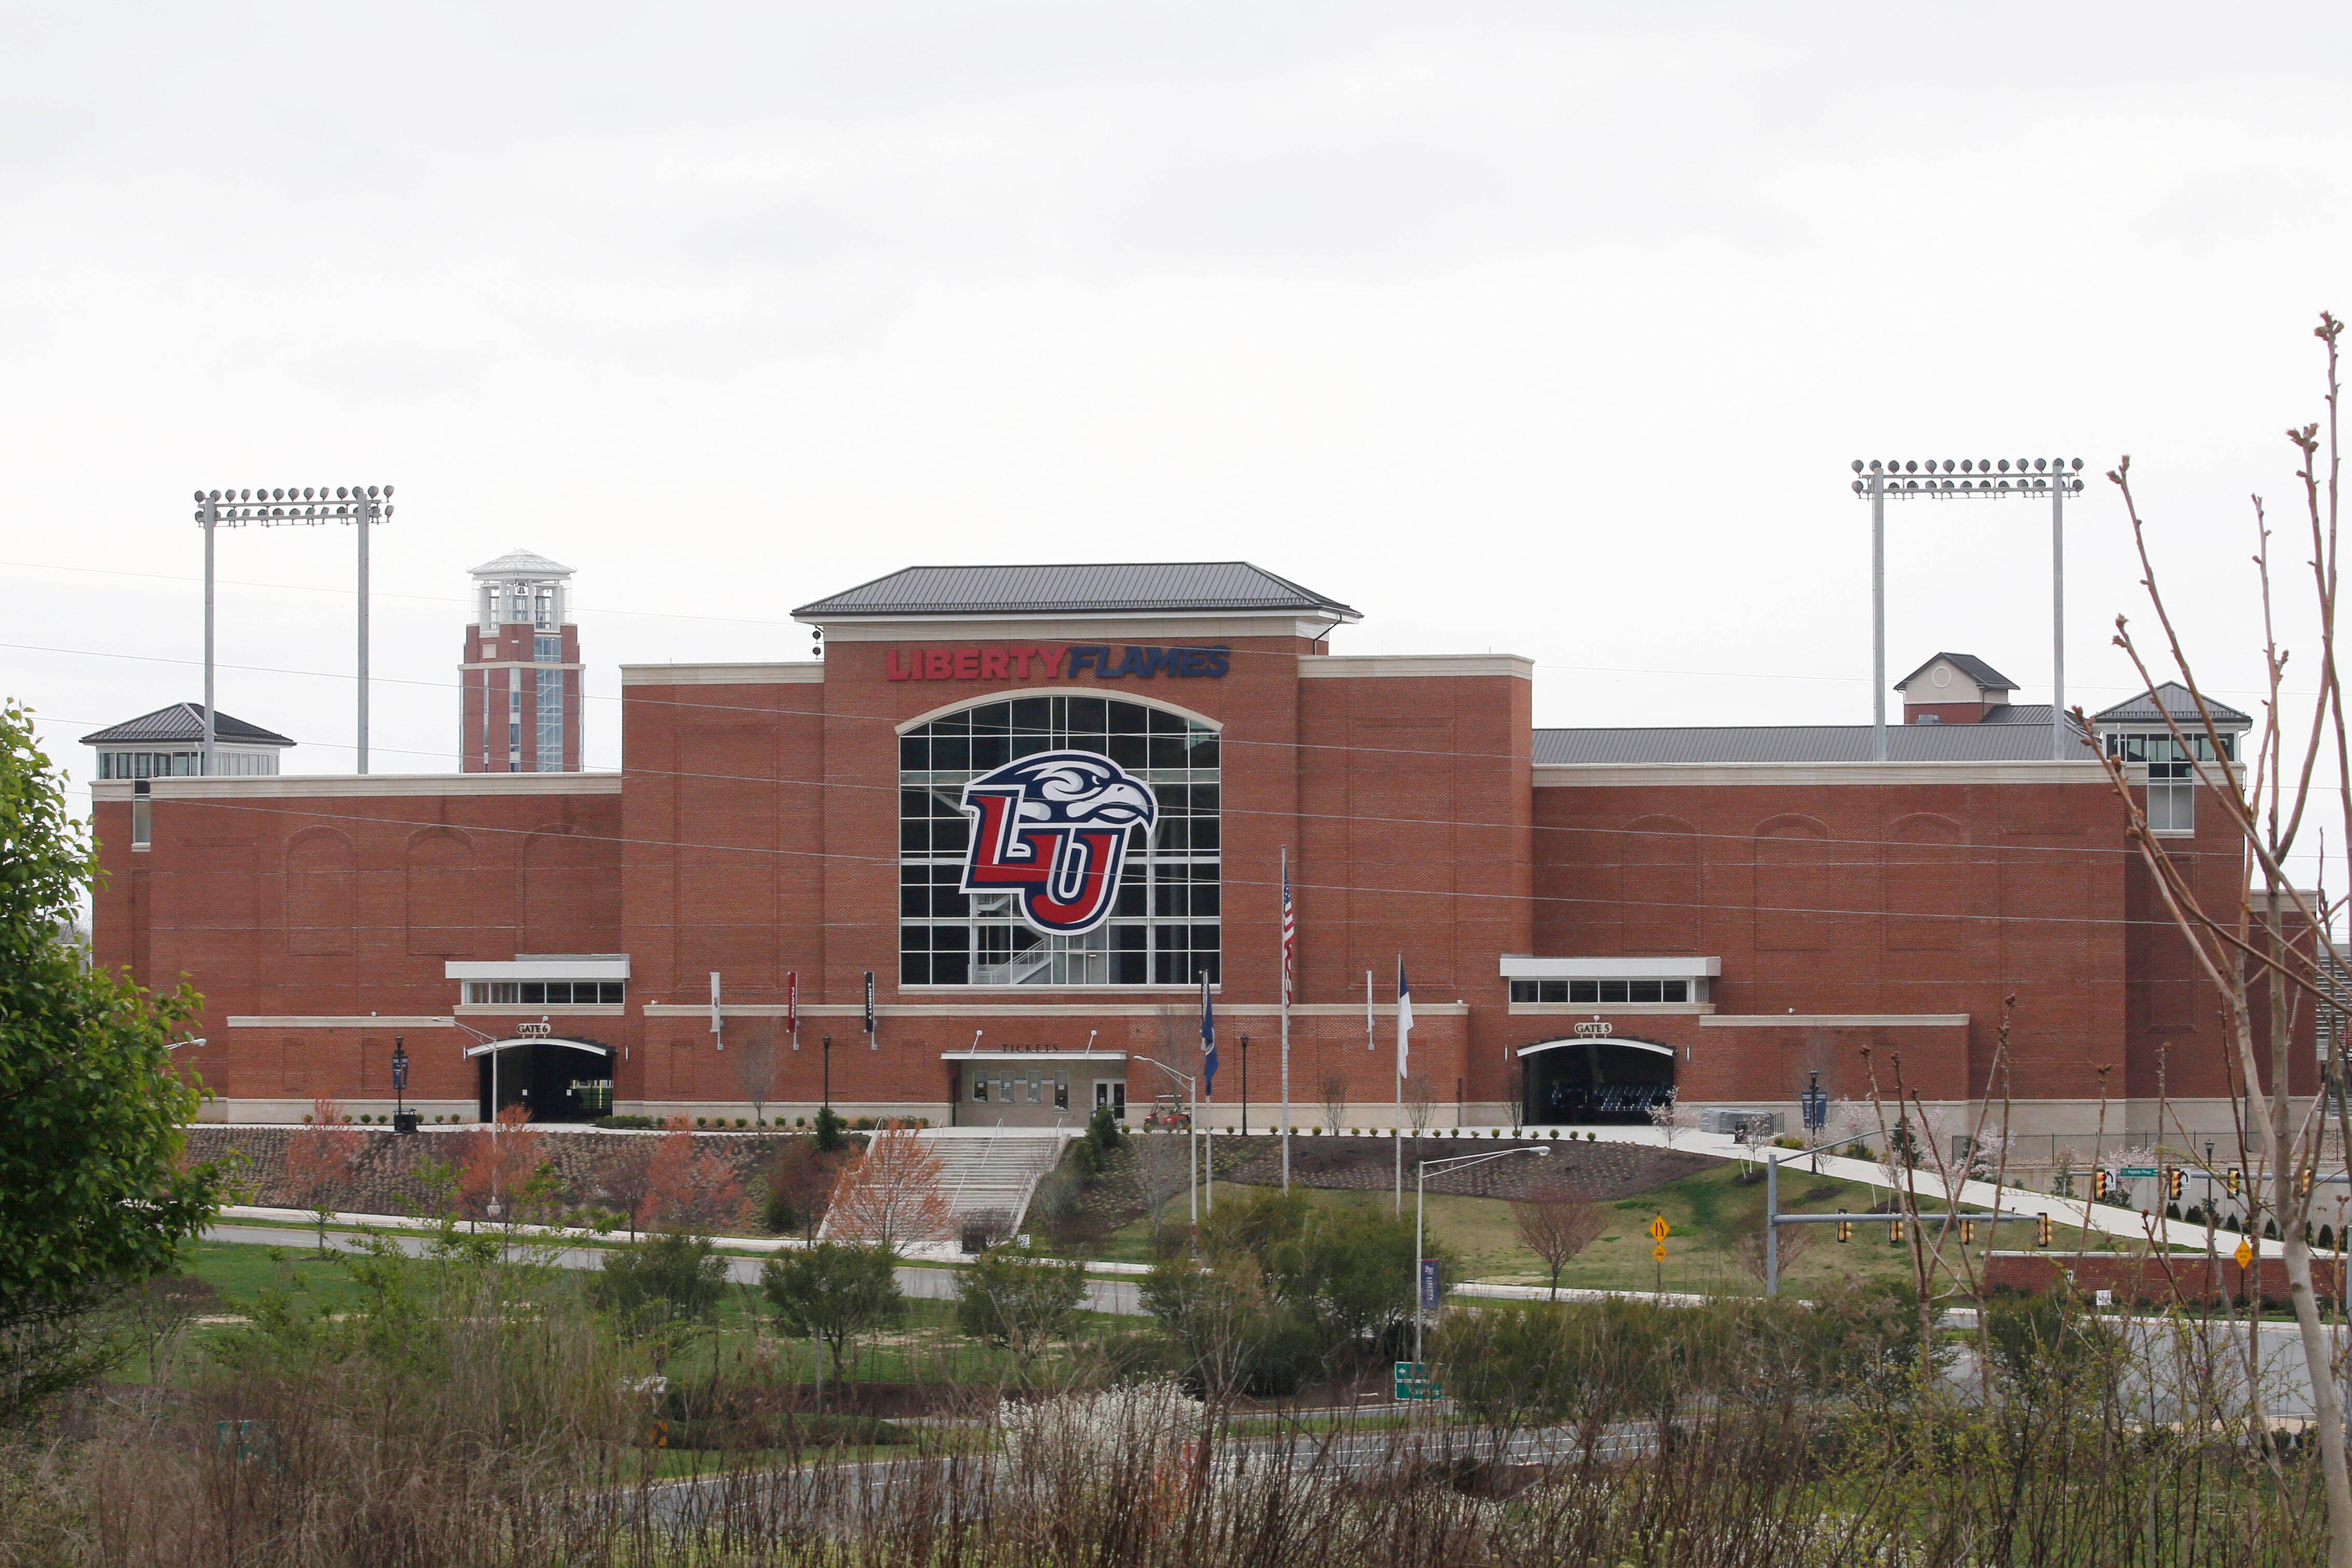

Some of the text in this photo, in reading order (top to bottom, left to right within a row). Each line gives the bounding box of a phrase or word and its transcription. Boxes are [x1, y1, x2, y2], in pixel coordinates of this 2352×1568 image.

[886, 645, 1232, 681] LIBERTY FLAMES
[960, 785, 1131, 936] LU
[517, 1025, 548, 1033] GATE 6
[1576, 1024, 1609, 1033] GATE 5
[1002, 1043, 1059, 1053] TICKETS
